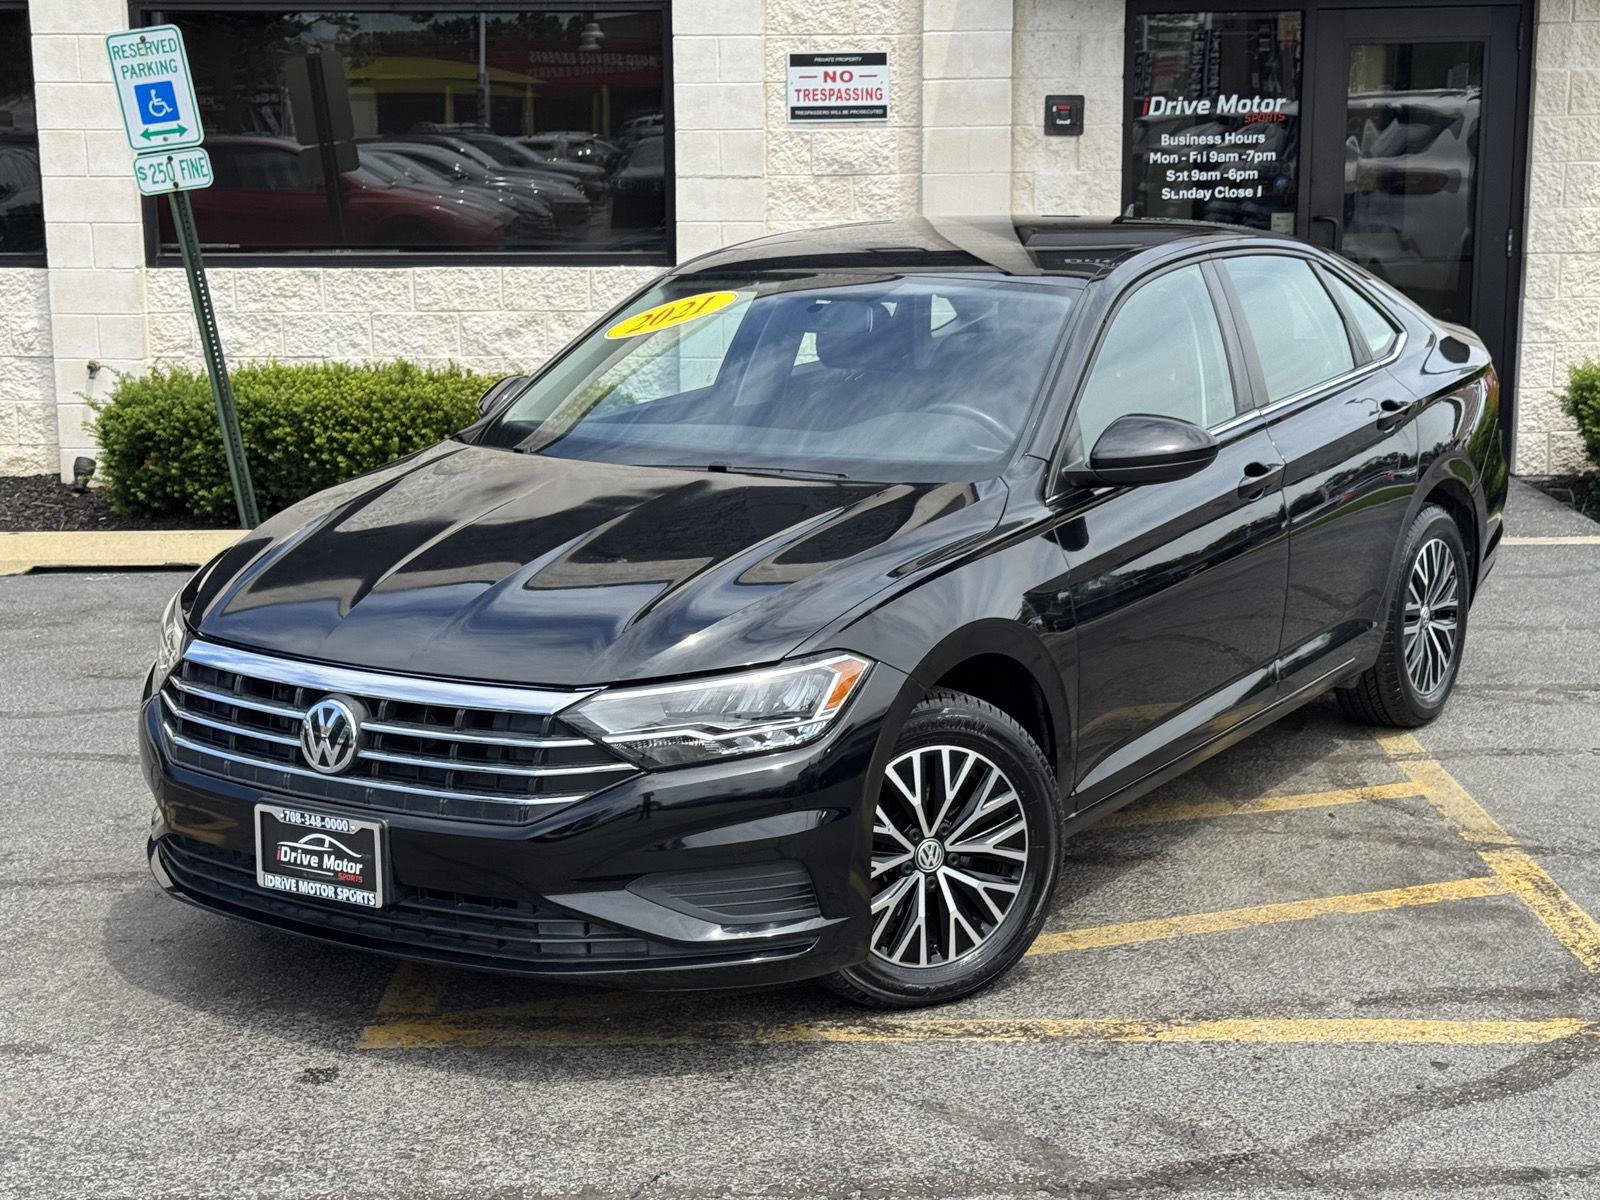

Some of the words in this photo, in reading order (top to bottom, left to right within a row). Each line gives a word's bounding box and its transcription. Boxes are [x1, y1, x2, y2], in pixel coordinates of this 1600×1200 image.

[111, 38, 177, 61] RESERVED
[121, 58, 178, 80] PARKING
[823, 70, 854, 83] NO
[794, 87, 884, 102] TRESPASSING
[1141, 96, 1211, 116] iDrive
[1216, 94, 1287, 115] Motor
[1244, 112, 1286, 123] SPORTS
[1160, 134, 1221, 146] Business
[1224, 133, 1266, 144] Hours
[1149, 152, 1178, 164] Mon
[1209, 151, 1239, 163] 9am
[137, 161, 176, 185] $250
[179, 157, 209, 180] FINE
[1166, 170, 1189, 182] Sat
[1191, 169, 1221, 181] 9am
[1161, 187, 1212, 201] Sunday
[626, 296, 715, 334] 2021
[301, 699, 357, 773] VW
[284, 811, 349, 832] 708-348-0000
[275, 846, 319, 867] iDrive
[323, 854, 362, 874] Motor
[338, 872, 363, 883] SPORTS
[298, 880, 335, 898] MOTOR
[336, 888, 376, 906] SPORTS
